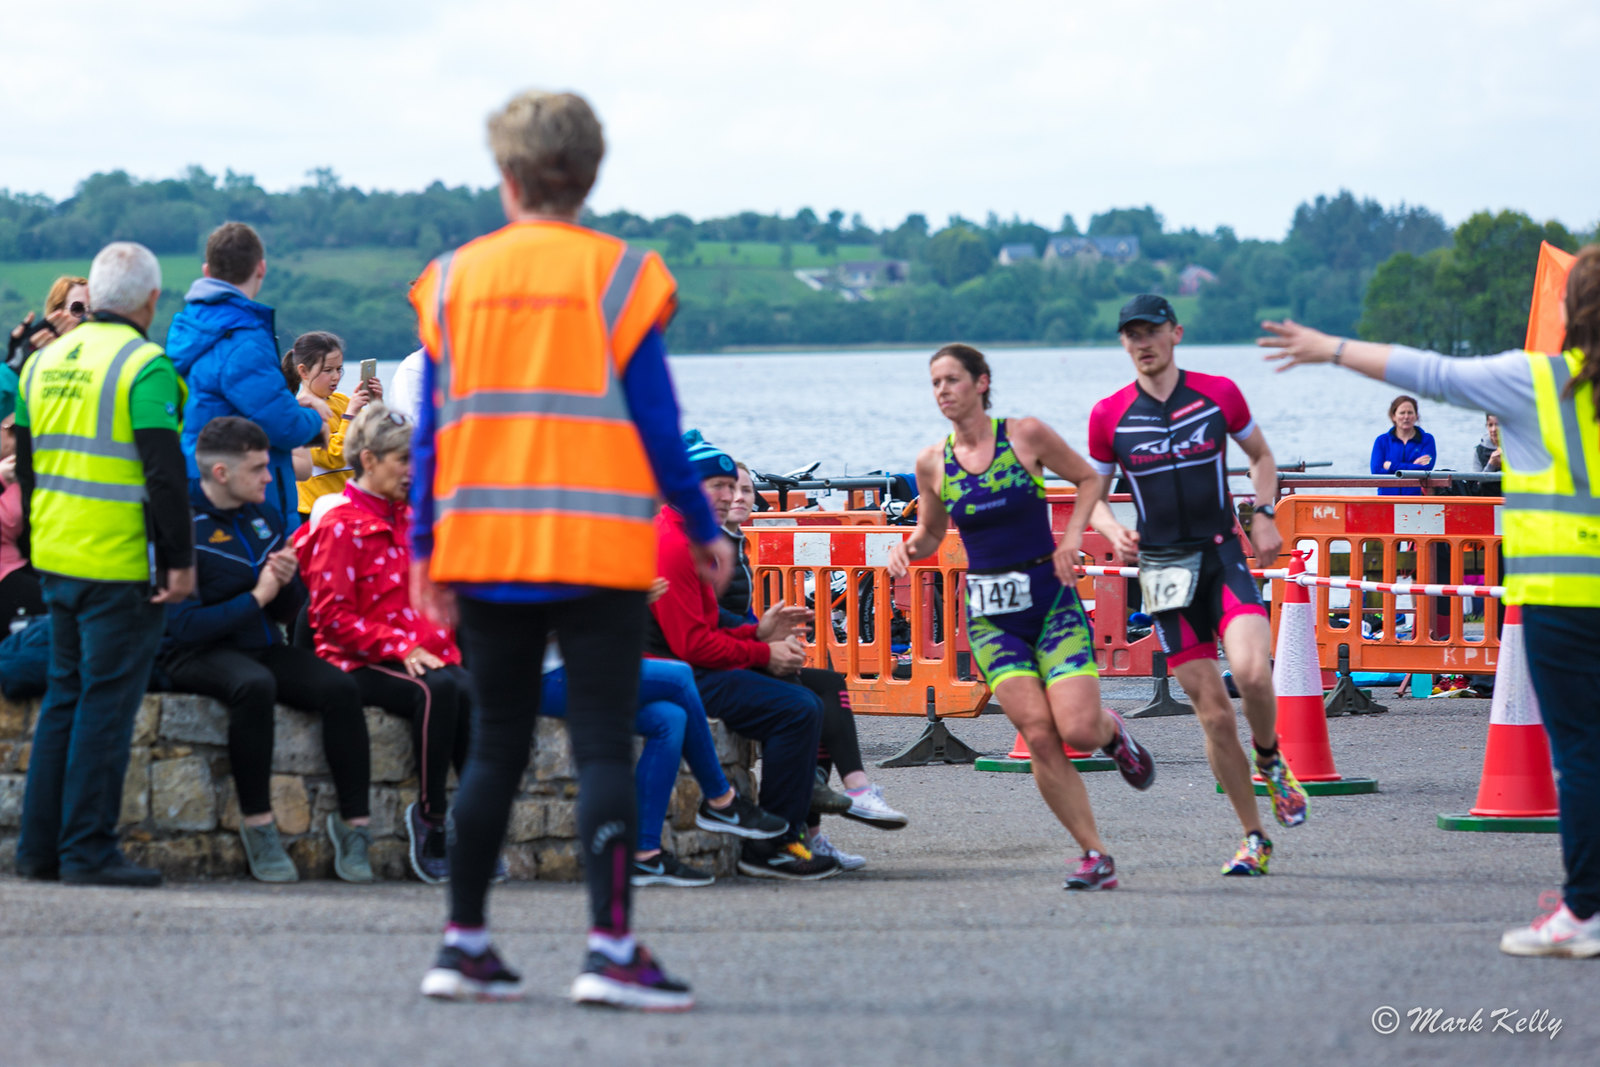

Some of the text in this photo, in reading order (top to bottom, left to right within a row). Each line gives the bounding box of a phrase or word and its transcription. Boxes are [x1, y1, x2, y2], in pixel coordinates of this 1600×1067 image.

[42, 369, 93, 384] TECHNICAL
[1313, 505, 1341, 520] KPL
[978, 581, 1020, 611] 142
[1444, 647, 1497, 666] KPL
